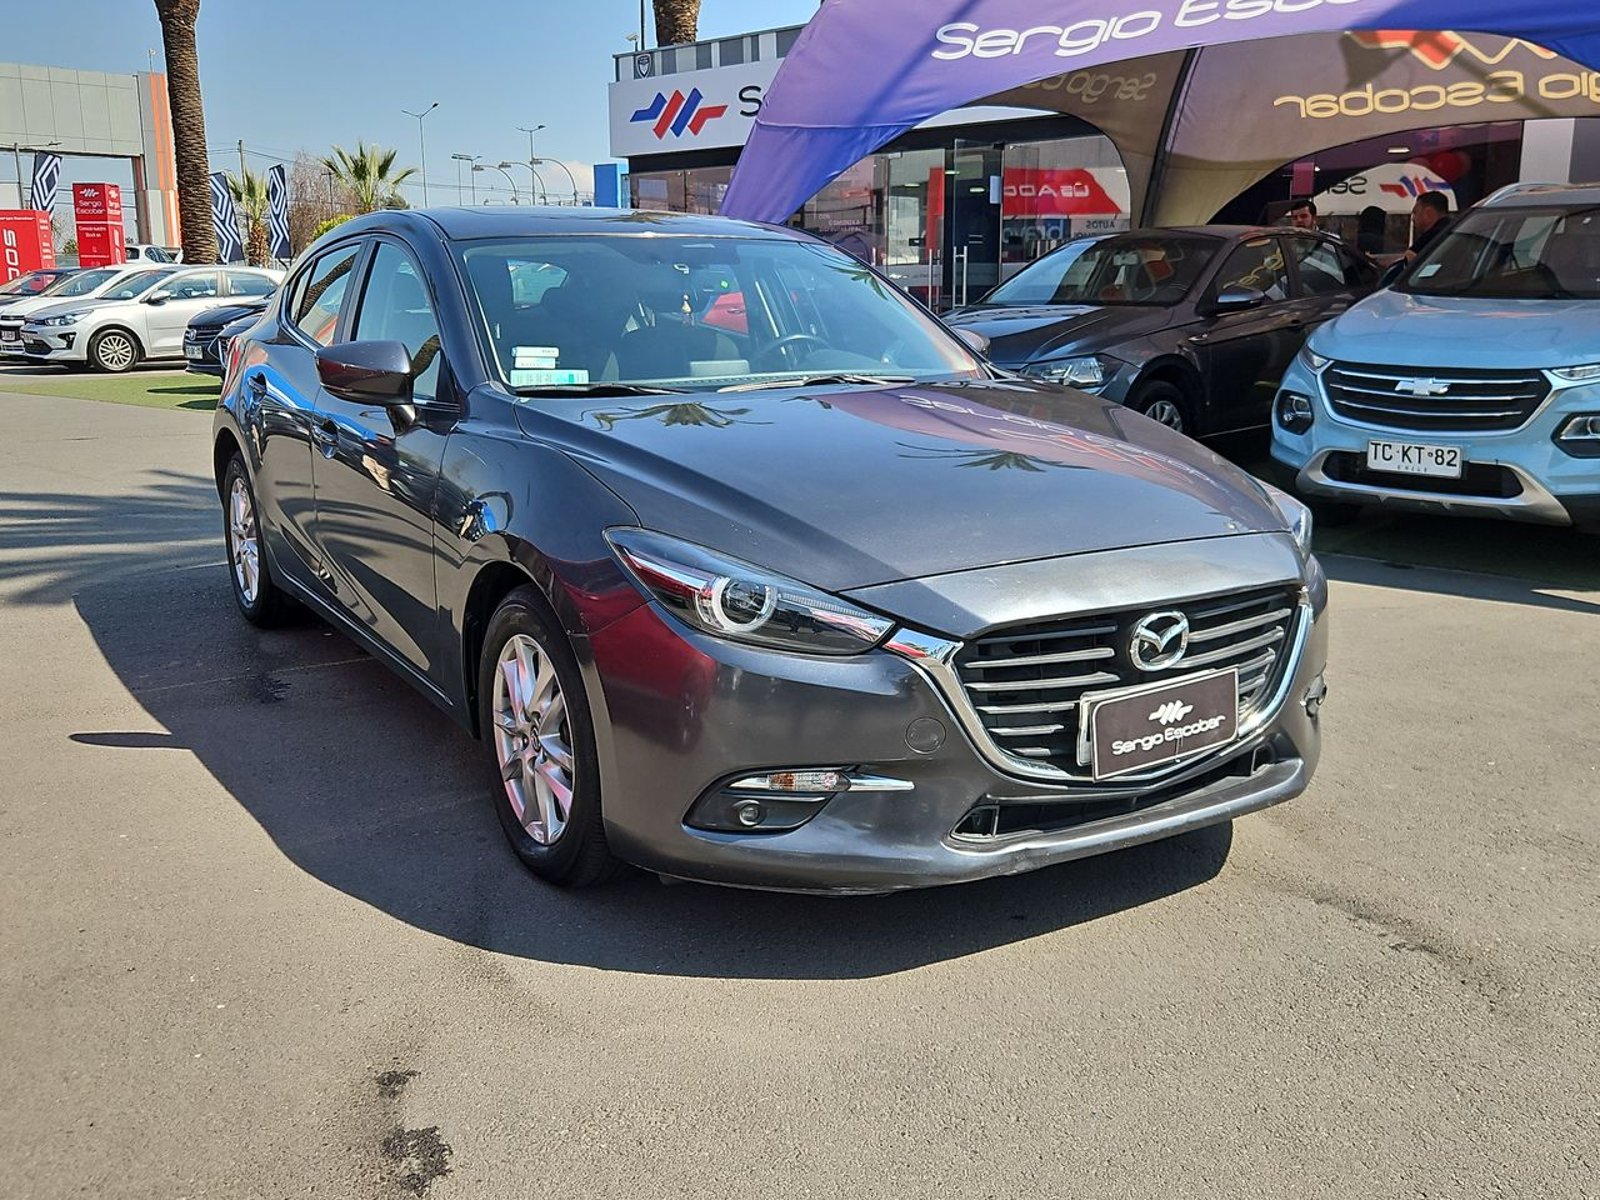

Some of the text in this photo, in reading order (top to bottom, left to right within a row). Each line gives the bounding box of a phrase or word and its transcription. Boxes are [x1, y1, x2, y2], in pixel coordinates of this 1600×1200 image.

[931, 10, 1162, 60] Sergio
[1112, 715, 1226, 755] Sergio Escobar
